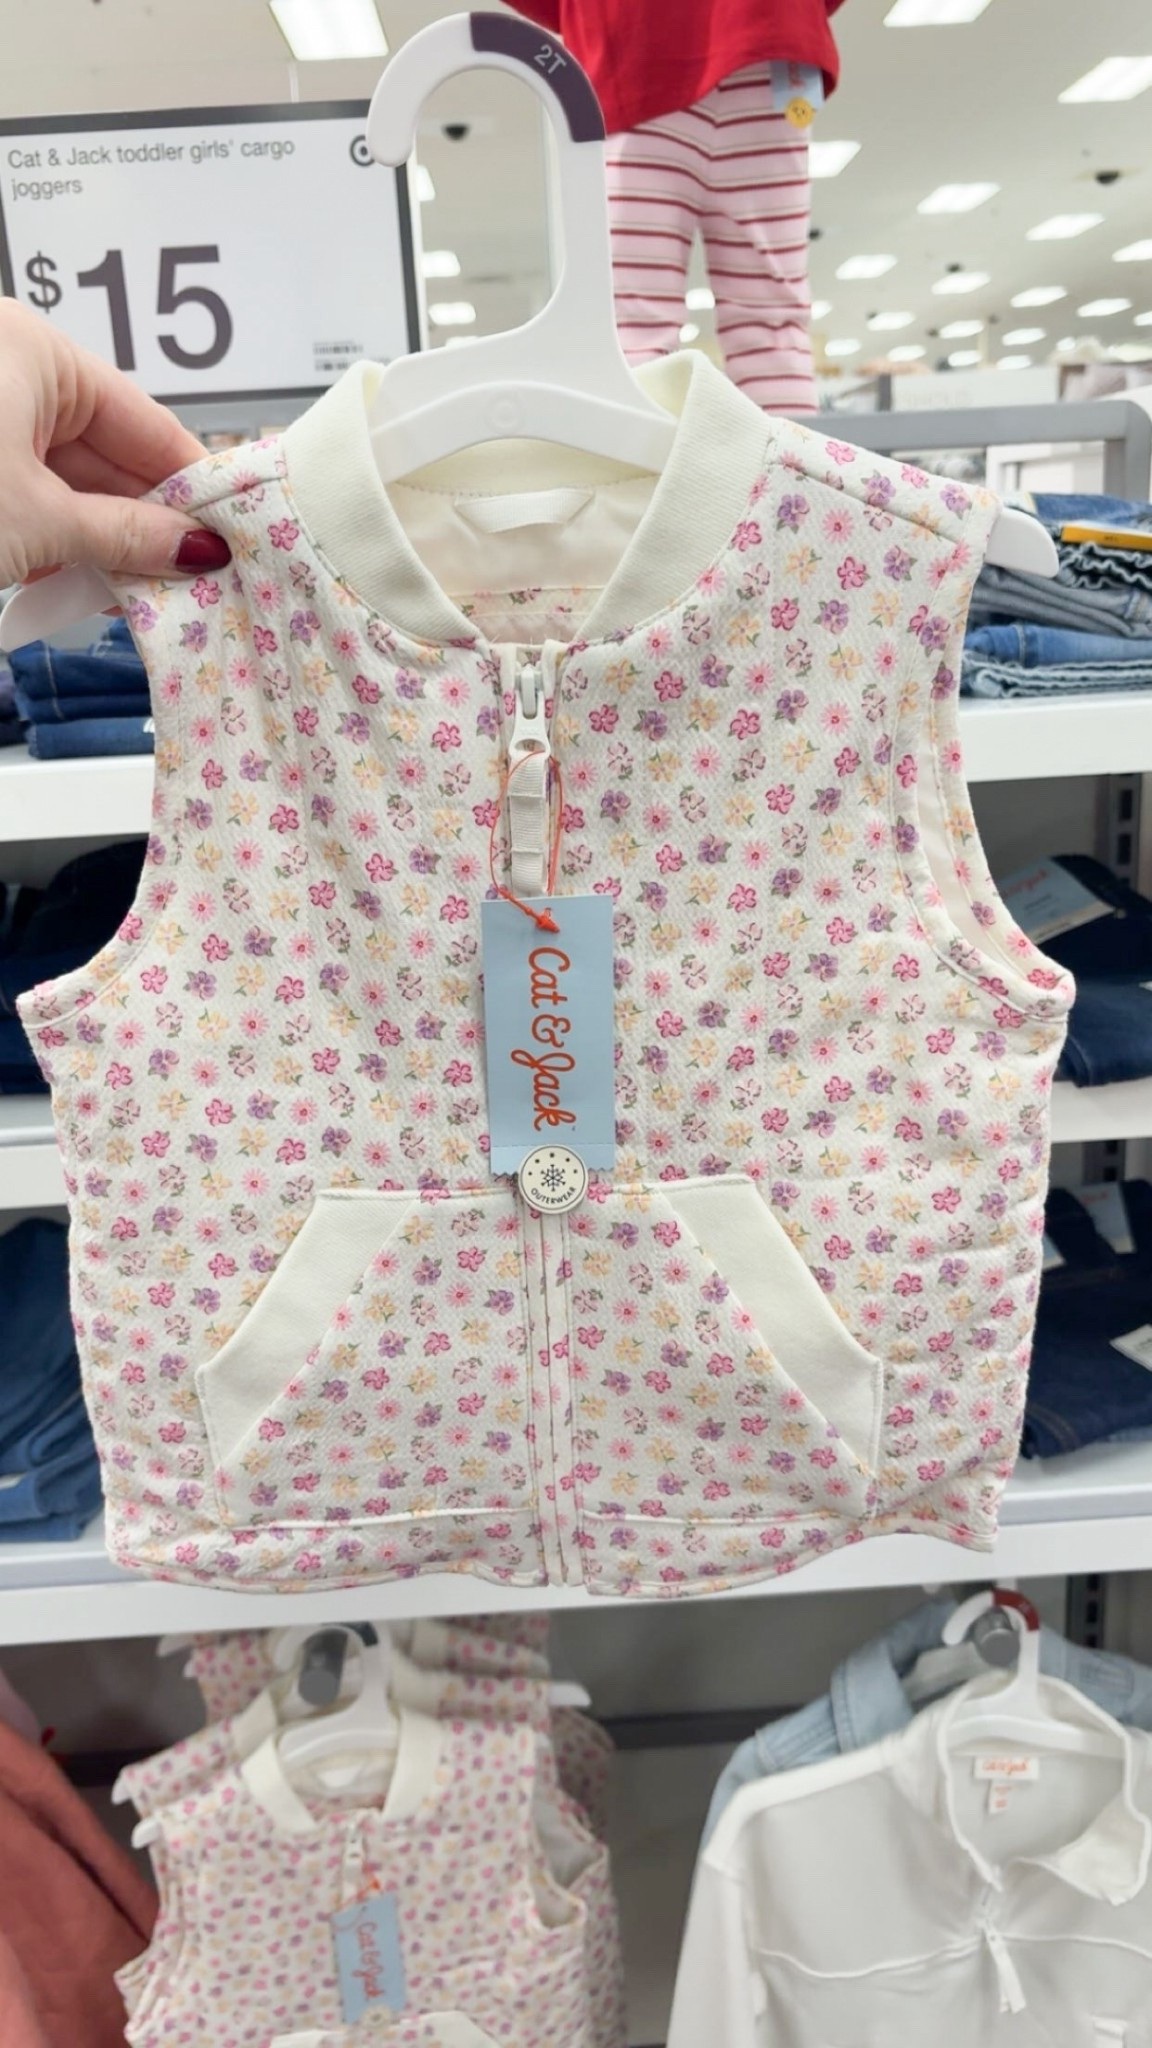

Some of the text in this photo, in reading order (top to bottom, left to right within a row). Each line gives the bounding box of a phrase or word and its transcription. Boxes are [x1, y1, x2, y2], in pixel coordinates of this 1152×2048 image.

[533, 44, 567, 74] 2T
[7, 139, 295, 169] Cat & Jack toddler girls' cargo
[11, 178, 83, 201] joggers
[511, 946, 577, 1132] Cat & Jack
[531, 1186, 576, 1204] OUTERWEAR
